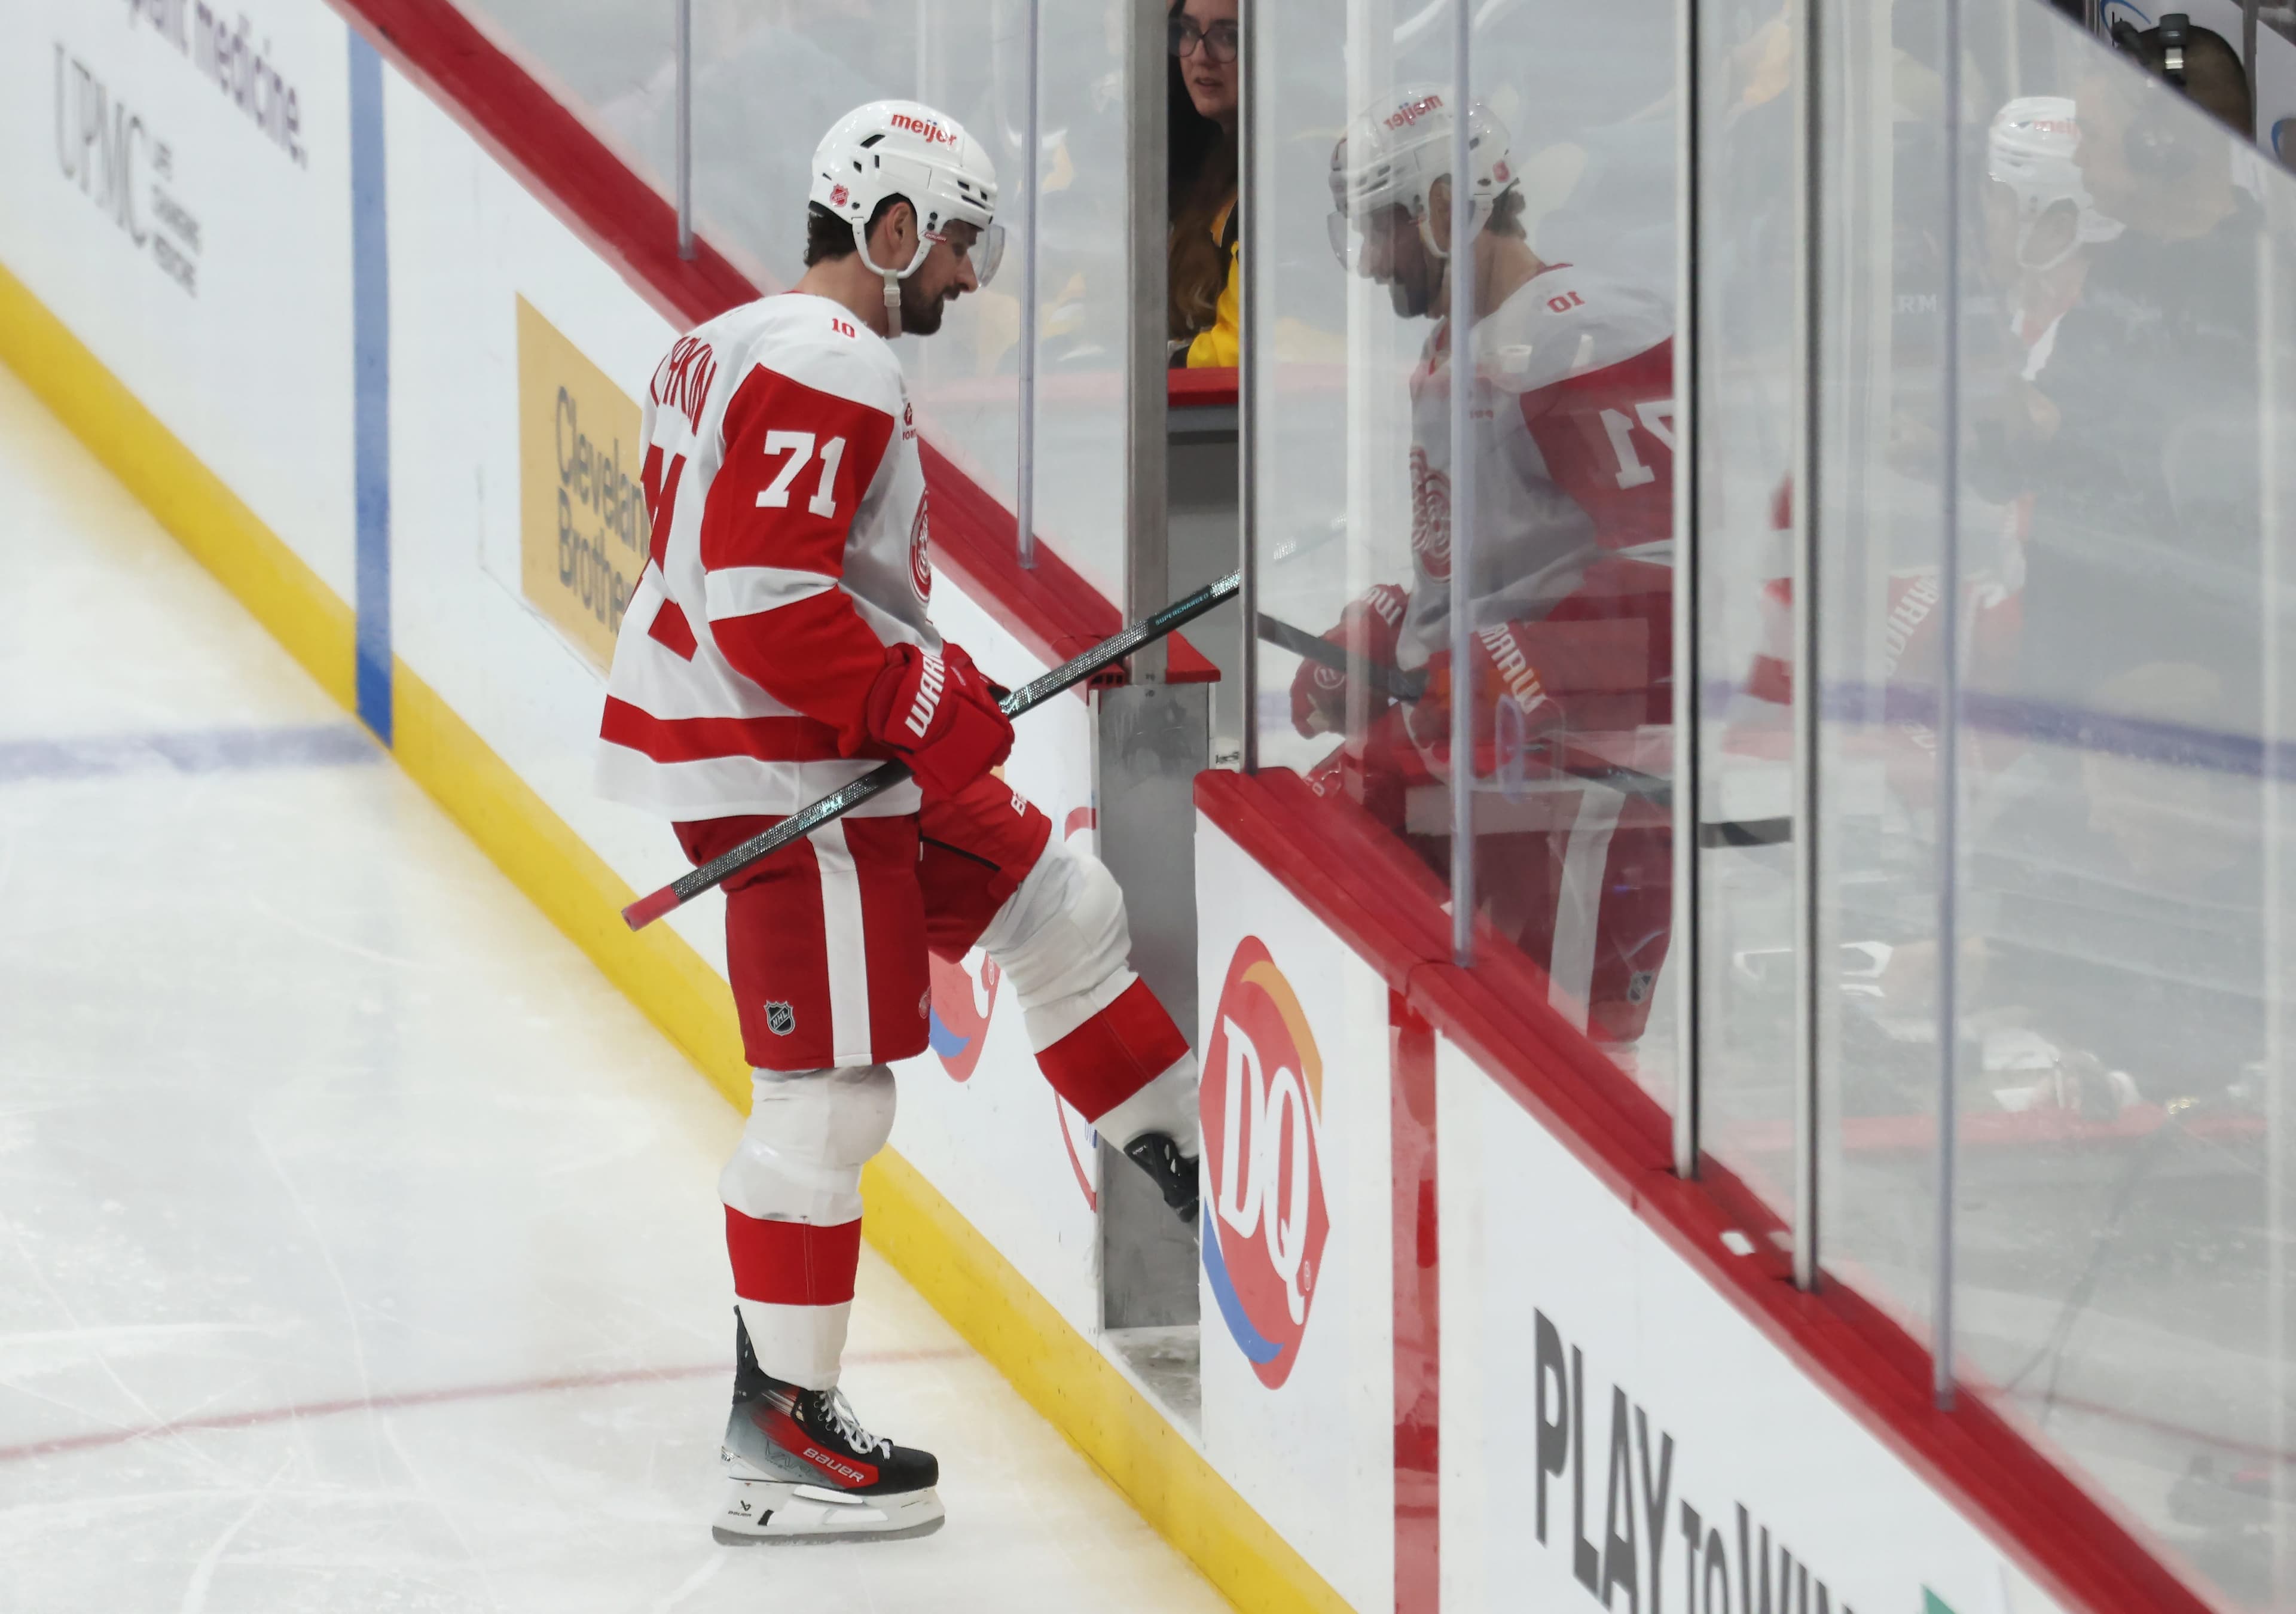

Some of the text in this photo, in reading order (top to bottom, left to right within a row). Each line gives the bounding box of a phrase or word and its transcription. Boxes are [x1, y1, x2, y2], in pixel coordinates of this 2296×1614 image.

[54, 44, 148, 248] UPMC
[891, 113, 957, 146] meijer
[832, 318, 855, 338] 10
[556, 386, 651, 560] Clevelan
[755, 429, 846, 519] 71
[1155, 593, 1210, 626] SUPERCHARGED
[773, 1011, 788, 1029] NHL
[1219, 1014, 1309, 1326] DQ
[1534, 1307, 1674, 1614] PLAY
